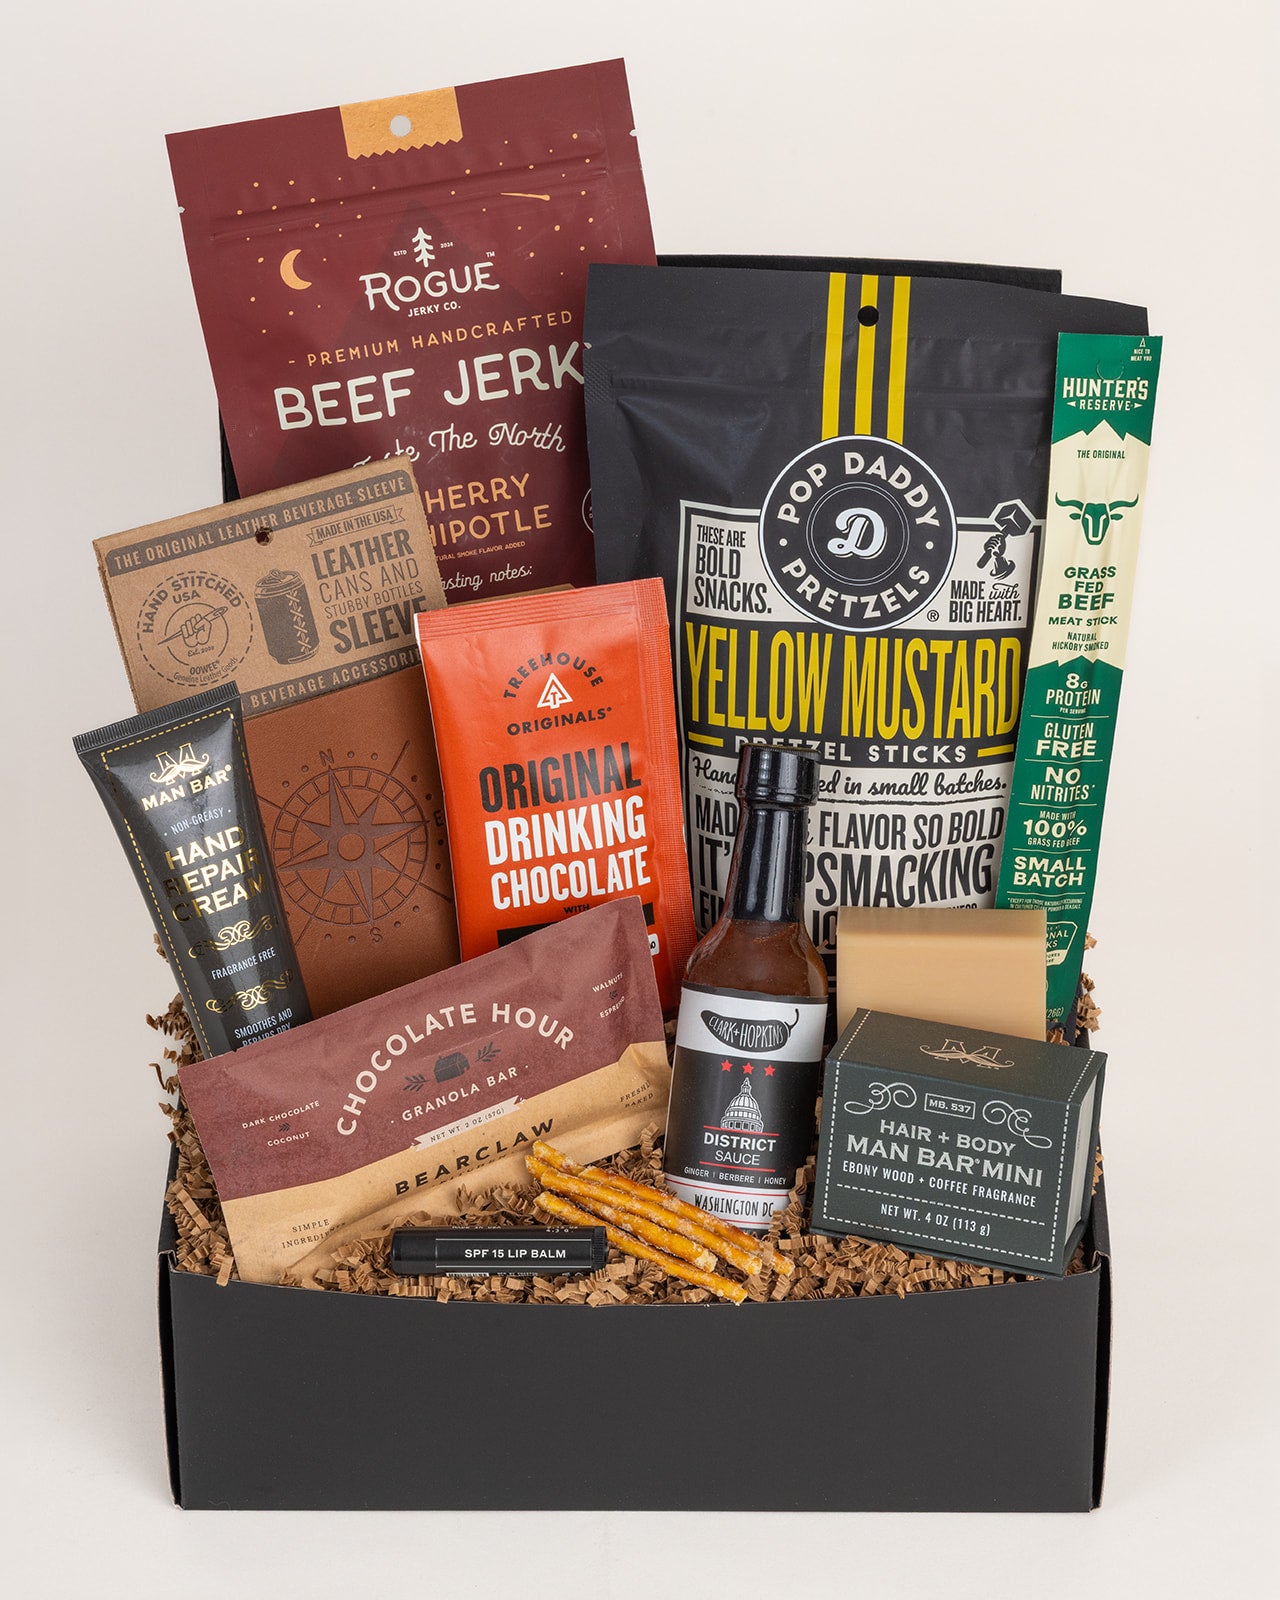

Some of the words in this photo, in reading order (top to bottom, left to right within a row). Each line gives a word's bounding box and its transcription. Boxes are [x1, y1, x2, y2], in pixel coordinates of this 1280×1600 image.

[359, 262, 500, 311] ROGUE
[408, 304, 440, 317] JERKY
[443, 301, 461, 310] CO.
[308, 339, 400, 366] PREMIUM
[412, 310, 573, 349] HANDCRAFTED
[274, 368, 415, 430] BEEF
[444, 341, 592, 406] JERK
[1062, 376, 1148, 400] HUNTER'S
[1080, 400, 1131, 411] RESERVE
[428, 422, 478, 452] The
[489, 422, 566, 452] North
[1077, 450, 1090, 458] THE
[1092, 450, 1126, 459] ORIGINAL
[424, 473, 530, 514] HERRY
[778, 463, 828, 524] POP
[844, 452, 941, 527] DADDY
[114, 551, 142, 571] THE
[146, 530, 214, 561] ORIGINAL
[218, 512, 278, 538] LEATHER
[282, 493, 352, 522] BEVERAGE
[356, 476, 406, 502] SLEEVE
[316, 524, 343, 540] MADE
[344, 520, 354, 530] IN
[354, 515, 373, 530] THE
[374, 509, 394, 524] USA
[430, 504, 552, 546] HIPOTLE
[696, 524, 724, 547] THESE
[726, 530, 746, 548] ARE
[311, 528, 414, 580] LEATHER
[457, 548, 478, 558] SMOKE
[479, 544, 504, 554] FLAVOR
[505, 541, 526, 550] ADDED
[696, 544, 741, 580] BOLD
[319, 570, 373, 604] CANS
[381, 558, 420, 588] AND
[440, 572, 482, 591] asting
[490, 563, 532, 583] notes:
[1064, 566, 1116, 580] GRASS
[1074, 580, 1104, 593] FED
[172, 590, 200, 604] USA
[324, 595, 371, 620] STUBBY
[374, 580, 424, 605] BOTTLES
[694, 580, 772, 614] SNACKS.
[781, 557, 930, 619] PRETZELS
[950, 580, 986, 600] MADE
[988, 582, 1020, 600] with
[1058, 592, 1114, 610] BEEF
[142, 590, 168, 633] HAND
[172, 576, 241, 608] STITCHED
[949, 601, 974, 623] BIG
[976, 600, 1022, 622] HEART.
[1048, 616, 1082, 626] MEAT
[1086, 616, 1118, 626] STICK
[1052, 641, 1083, 652] HICKORY
[1084, 642, 1110, 652] SMOKED
[1067, 632, 1096, 642] NATURAL
[250, 676, 326, 710] BEVERAGE
[332, 651, 420, 686] ACCESSORI
[503, 652, 604, 700] TREEHOUSE
[685, 622, 833, 734] YELLOW
[841, 635, 1022, 740] MUSTARD
[1046, 688, 1100, 707] PROTEIN
[1044, 722, 1094, 740] GLUTEN
[320, 748, 334, 766] N
[868, 745, 966, 764] STICKS
[1036, 740, 1097, 758] FREE
[479, 742, 642, 813] ORIGINAL
[845, 771, 863, 794] in
[868, 772, 929, 796] small
[934, 768, 1007, 796] batches.
[1044, 766, 1080, 784] NO
[142, 786, 185, 810] MAN
[170, 808, 224, 836] NON-GREASY
[819, 810, 906, 850] FLAVOR
[912, 814, 943, 850] SO
[948, 806, 1005, 845] BOLD
[1024, 820, 1087, 838] 100%
[1040, 810, 1060, 820] MADE
[1062, 810, 1076, 820] WITH
[484, 795, 646, 866] DRINKING
[1028, 838, 1050, 848] GRASS
[1052, 839, 1064, 848] FED
[1066, 838, 1080, 847] BEEF
[164, 826, 245, 870] HAND
[163, 848, 260, 899] REPAIR
[491, 846, 651, 910] CHOCOLATE
[805, 844, 996, 908] SMACKING
[1014, 856, 1086, 872] SMALL
[1013, 872, 1084, 888] BATCH
[172, 873, 268, 922] CREAM
[564, 904, 590, 914] WITH
[370, 926, 384, 944] S
[212, 956, 257, 980] FRAGRANCE
[258, 947, 276, 962] FREE
[234, 1016, 278, 1039] SMOOTHES
[278, 1008, 293, 1022] AND
[336, 1003, 477, 1136] CHOCOLATE
[492, 1002, 574, 1050] HOUR
[402, 1083, 480, 1122] GRANOLA
[486, 1066, 518, 1087] BAR
[929, 1098, 948, 1111] MB.
[950, 1103, 972, 1114] 537
[242, 1118, 266, 1129] DARK
[269, 1100, 320, 1122] CHOCOLATE
[267, 1132, 310, 1147] COCONUT
[430, 1132, 446, 1142] NET
[472, 1117, 482, 1126] OZ
[703, 1132, 776, 1152] DISTRICT
[880, 1119, 932, 1143] HAIR
[938, 1132, 950, 1144] +
[956, 1134, 1016, 1157] BODY
[395, 1118, 554, 1196] BEARCLAW
[714, 1150, 760, 1166] SAUCE
[847, 1134, 909, 1162] MAN
[982, 1159, 1043, 1188] MINI
[684, 1166, 710, 1178] GINGER
[718, 1172, 755, 1184] BERBERE
[764, 1177, 786, 1186] HONEY
[842, 1160, 878, 1178] EBONY
[882, 1168, 914, 1184] WOOD
[929, 1177, 968, 1195] COFFEE
[972, 1184, 1036, 1208] FRAGRANCE
[694, 1194, 760, 1217] WASHINGTON
[762, 1202, 774, 1218] DC
[880, 1203, 899, 1218] NET
[903, 1207, 920, 1222] WT.
[924, 1212, 932, 1224] 4
[936, 1214, 948, 1227] OZ
[952, 1216, 976, 1232] (113
[292, 1218, 330, 1232] SIMPLE
[464, 1249, 490, 1258] SPF
[492, 1249, 504, 1258] 15
[508, 1249, 527, 1258] LIP
[531, 1249, 566, 1258] BALM
